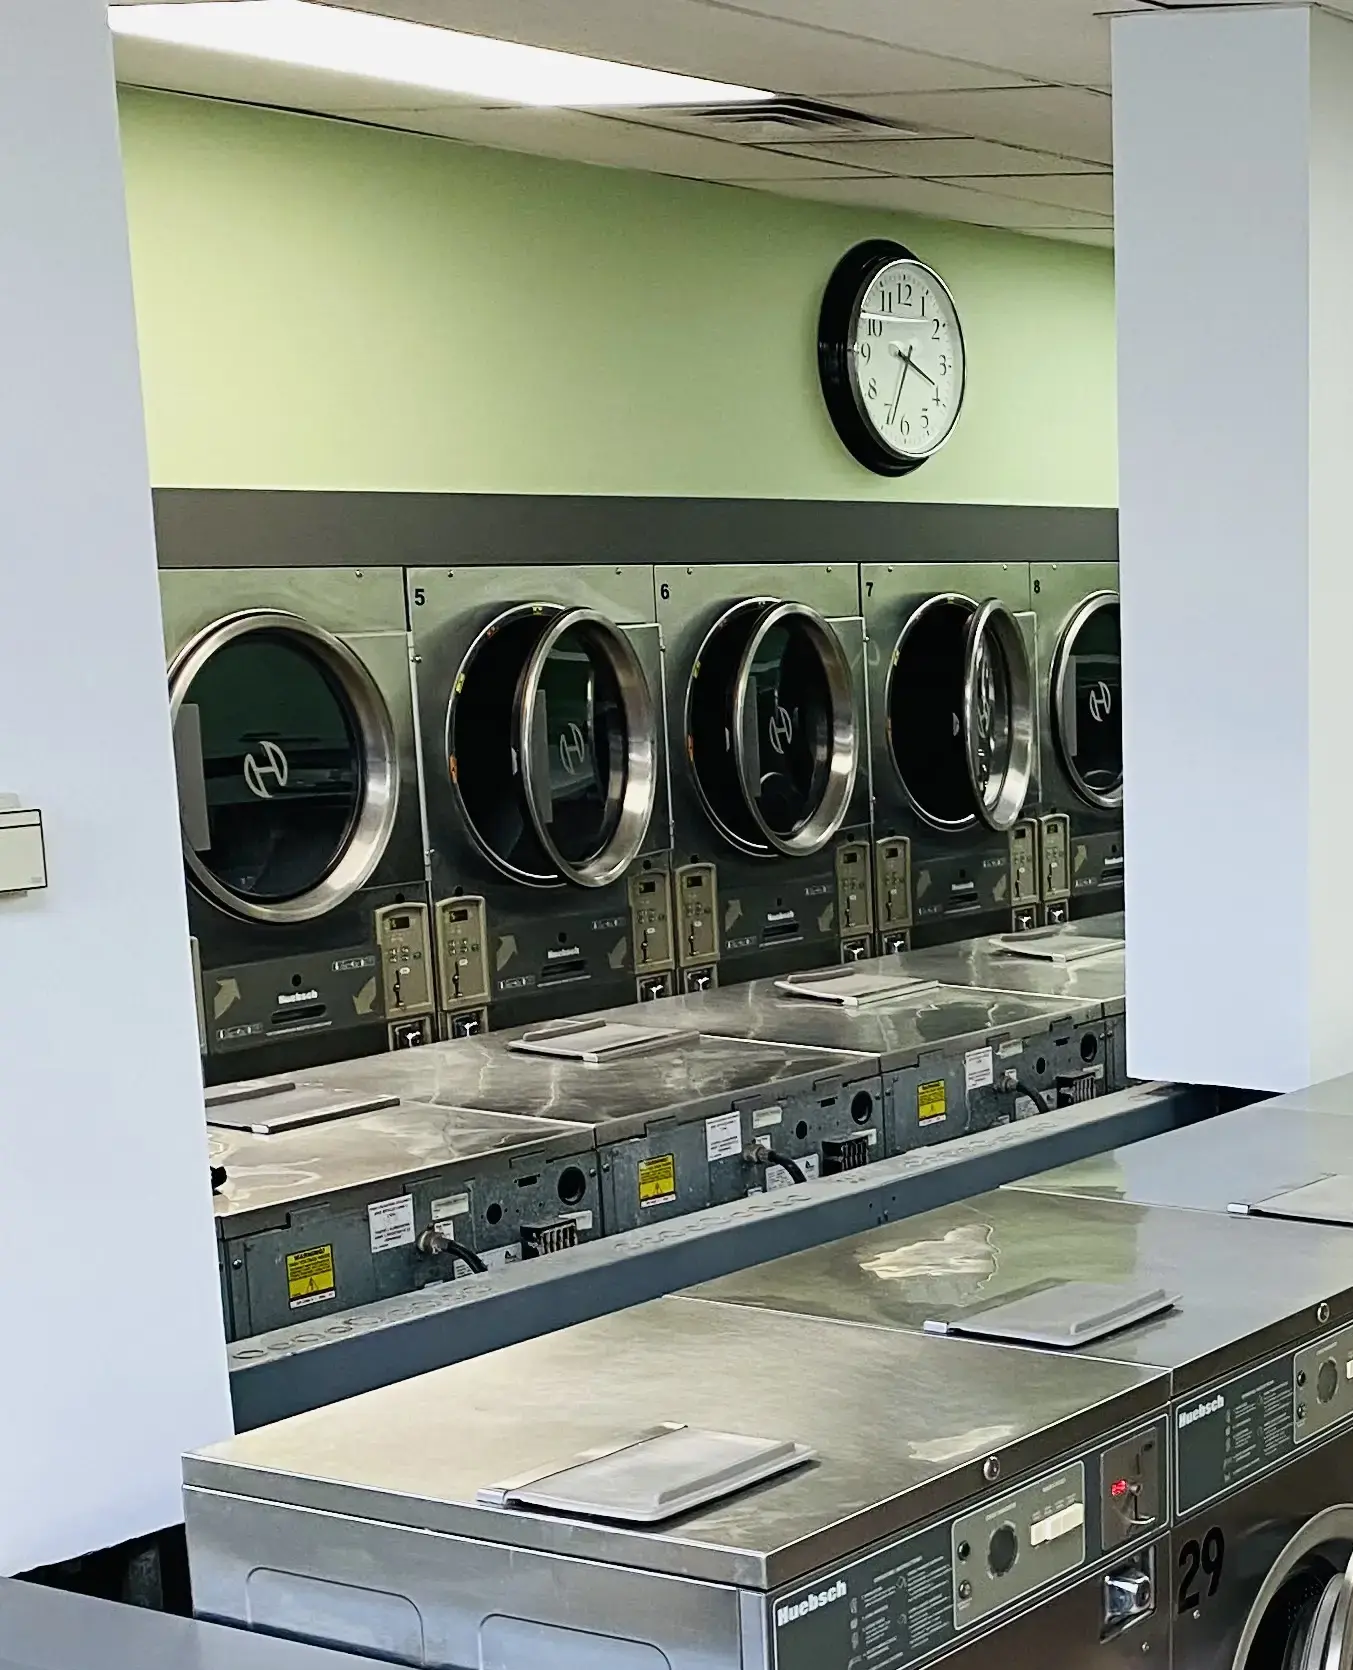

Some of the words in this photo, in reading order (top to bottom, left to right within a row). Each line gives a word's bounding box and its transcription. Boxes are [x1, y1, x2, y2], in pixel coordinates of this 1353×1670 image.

[880, 290, 893, 313] 11
[896, 283, 912, 306] 12
[921, 296, 926, 317] 1
[867, 319, 882, 337] 10
[931, 318, 940, 340] 2
[861, 343, 871, 364] 9
[939, 354, 947, 376] 3
[868, 378, 877, 399] 8
[884, 403, 893, 425] 7
[921, 408, 929, 429] 5
[900, 414, 910, 436] 6
[414, 588, 426, 606] 5
[660, 583, 670, 600] 6
[866, 582, 874, 597] 7
[1033, 579, 1041, 594] 8
[1178, 1394, 1225, 1428] Huebsch
[1178, 1526, 1225, 1615] 29
[777, 1579, 847, 1627] Huebsch
